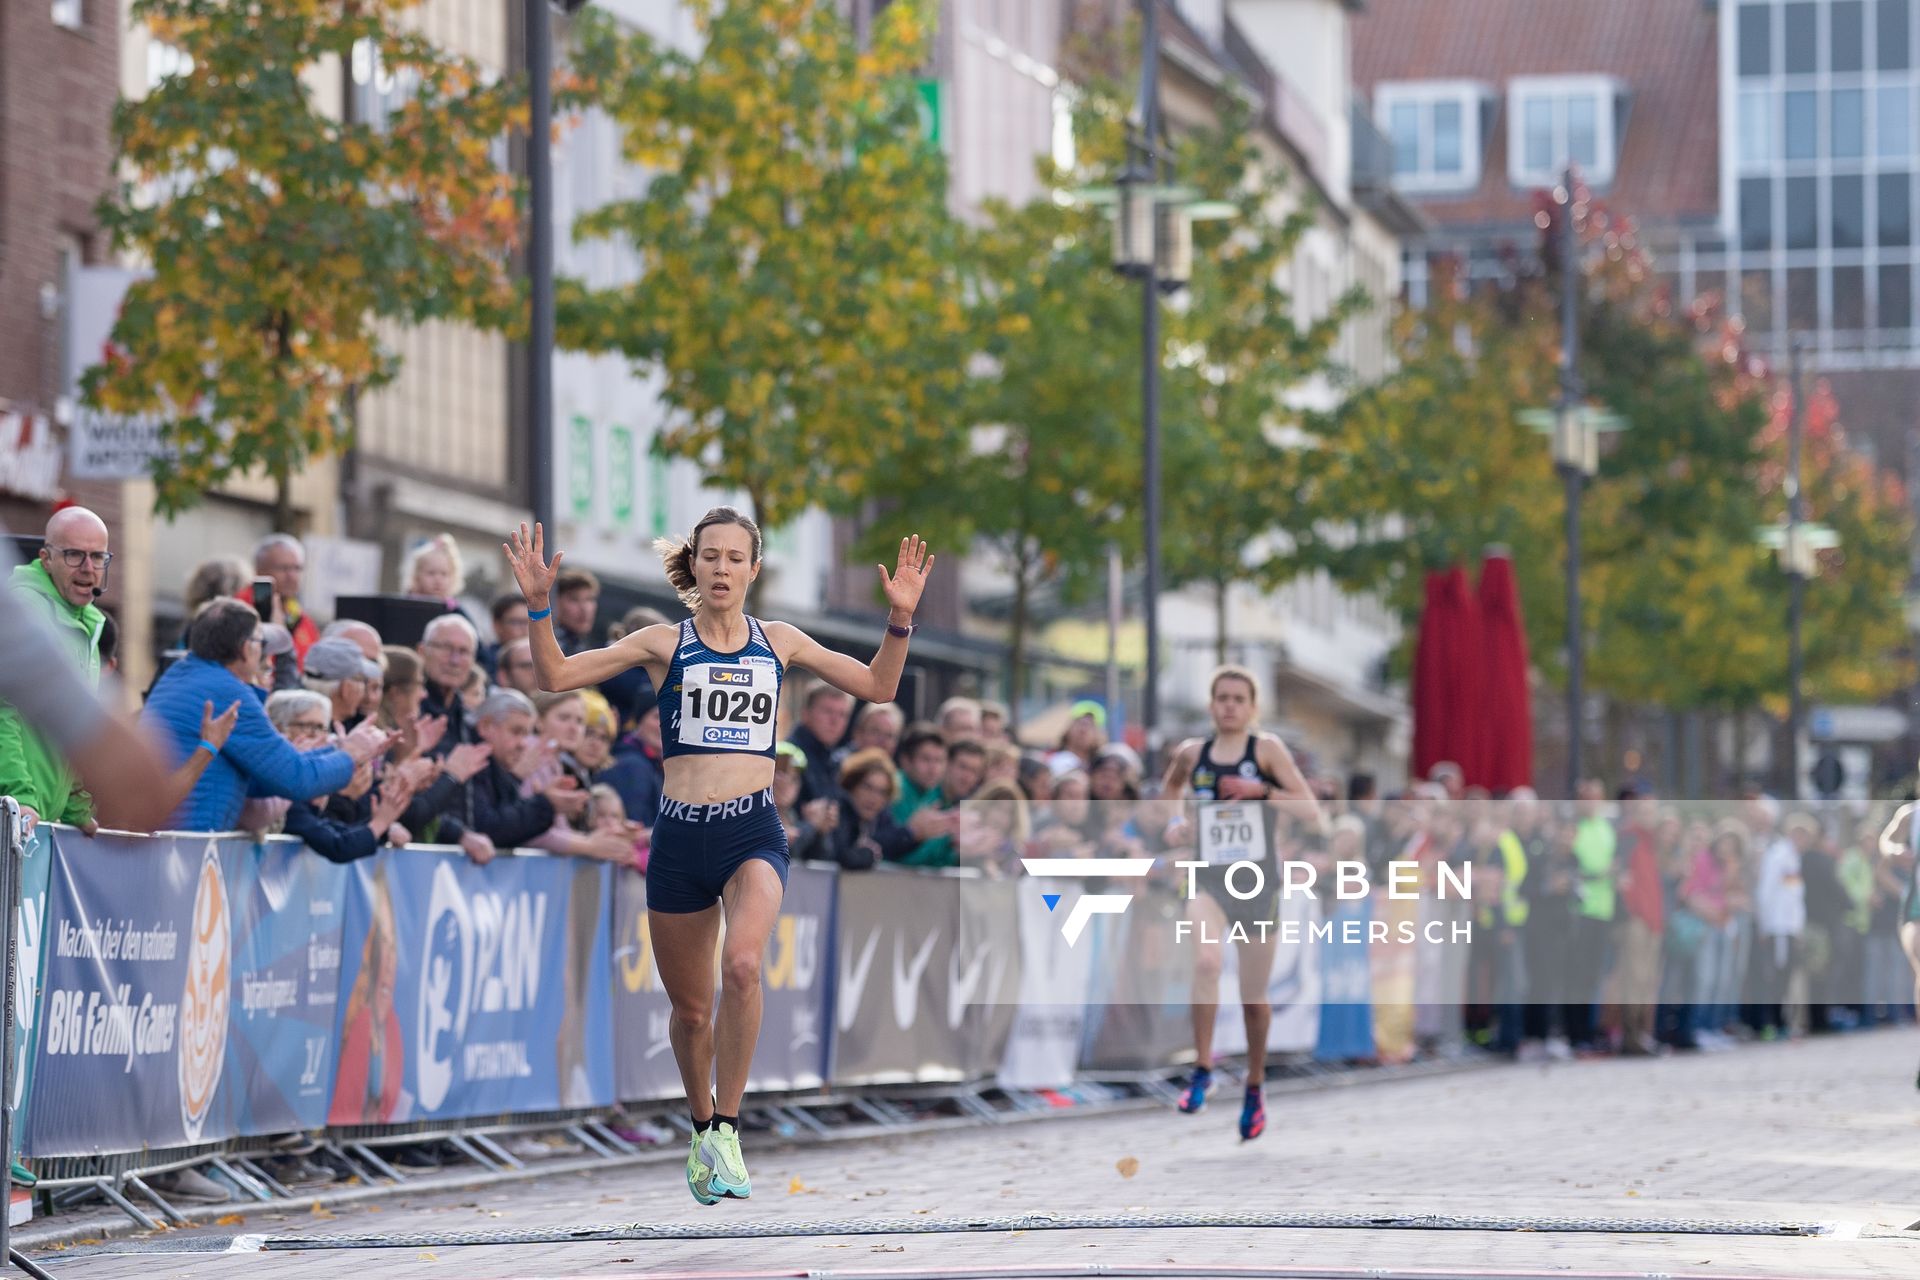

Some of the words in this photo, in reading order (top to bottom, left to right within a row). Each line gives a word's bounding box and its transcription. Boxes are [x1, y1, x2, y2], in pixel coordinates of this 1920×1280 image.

[732, 673, 750, 683] GLS
[687, 687, 772, 725] 1029
[722, 730, 748, 740] PLAN
[660, 794, 702, 822] NIKE
[705, 795, 753, 822] PRO
[1210, 824, 1253, 845] 970
[103, 918, 124, 960] bei
[121, 919, 142, 961] den
[7, 938, 16, 1028] www.eu-fence.com
[47, 989, 85, 1055] BIG
[83, 983, 139, 1073] Family
[135, 992, 177, 1055] Games
